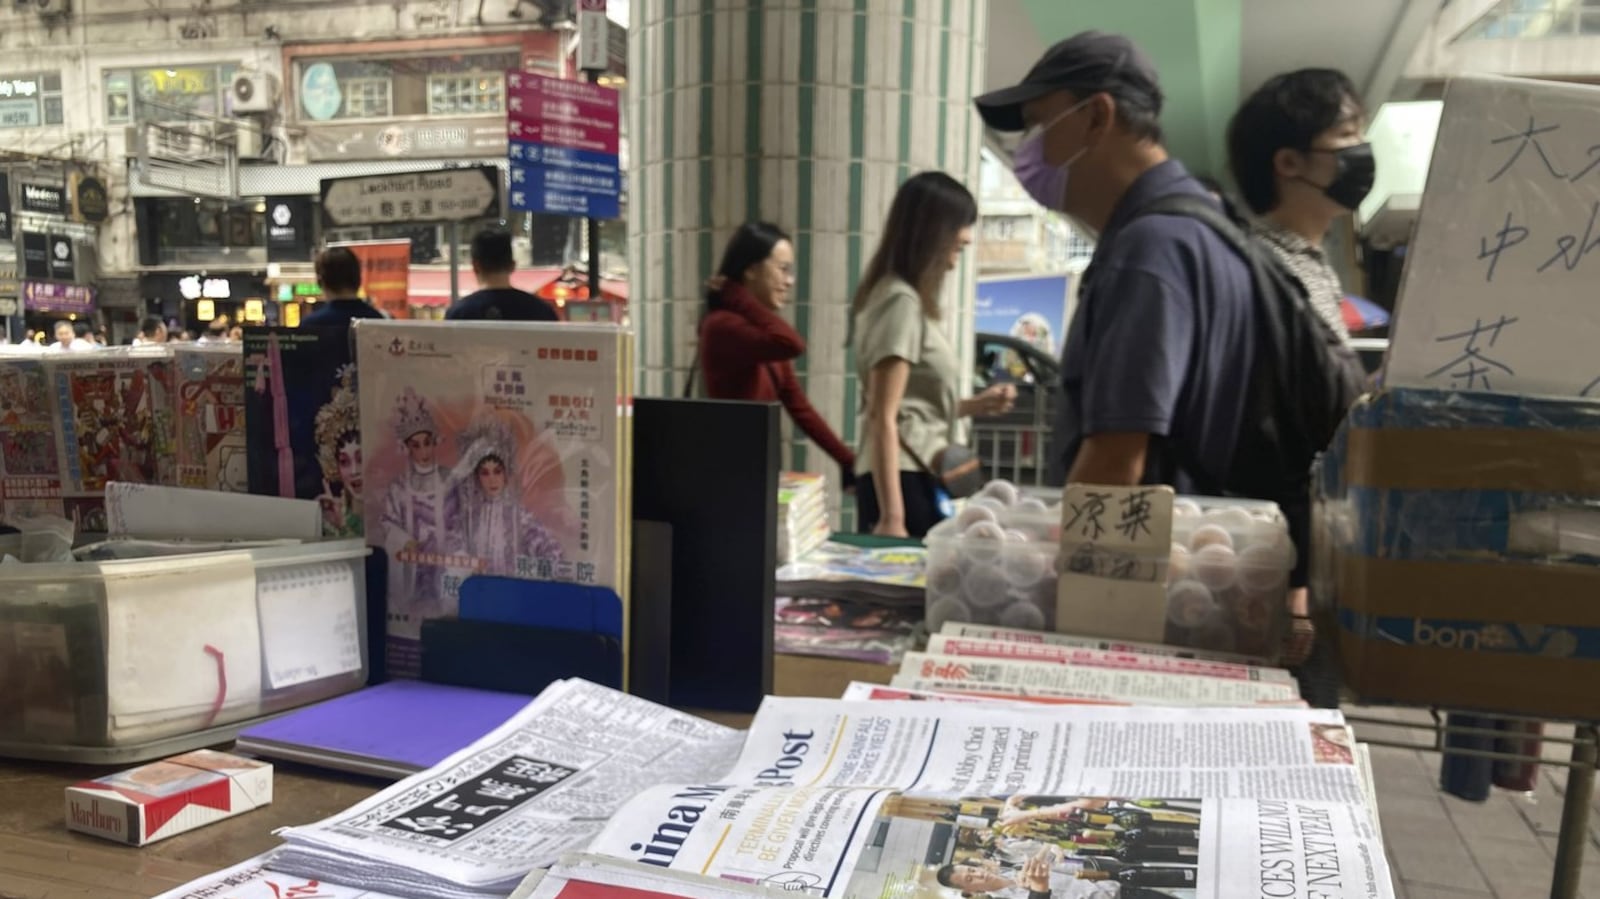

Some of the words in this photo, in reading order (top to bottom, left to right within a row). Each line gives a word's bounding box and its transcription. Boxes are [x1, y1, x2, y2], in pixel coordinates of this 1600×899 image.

[25, 186, 60, 201] Modern
[360, 179, 414, 195] Lockhart
[416, 174, 452, 190] Road
[380, 200, 433, 217] 駱克道
[1425, 315, 1519, 390] 茶
[516, 556, 595, 582] 東華三院
[963, 726, 985, 752] Choi
[987, 726, 1010, 772] recreated
[756, 729, 815, 780] Post
[70, 800, 122, 833] Marlboro
[719, 789, 760, 820] 南華早
[812, 799, 826, 815] legal
[767, 808, 802, 844] GIVEN
[799, 827, 811, 840] will
[803, 829, 827, 862] directives
[820, 805, 841, 831] covering
[804, 811, 819, 829] give
[1259, 817, 1293, 855] WILL
[757, 844, 781, 862] BE
[783, 839, 805, 869] Proposal
[1302, 837, 1342, 888] NEXT
[1258, 859, 1296, 899] CES
